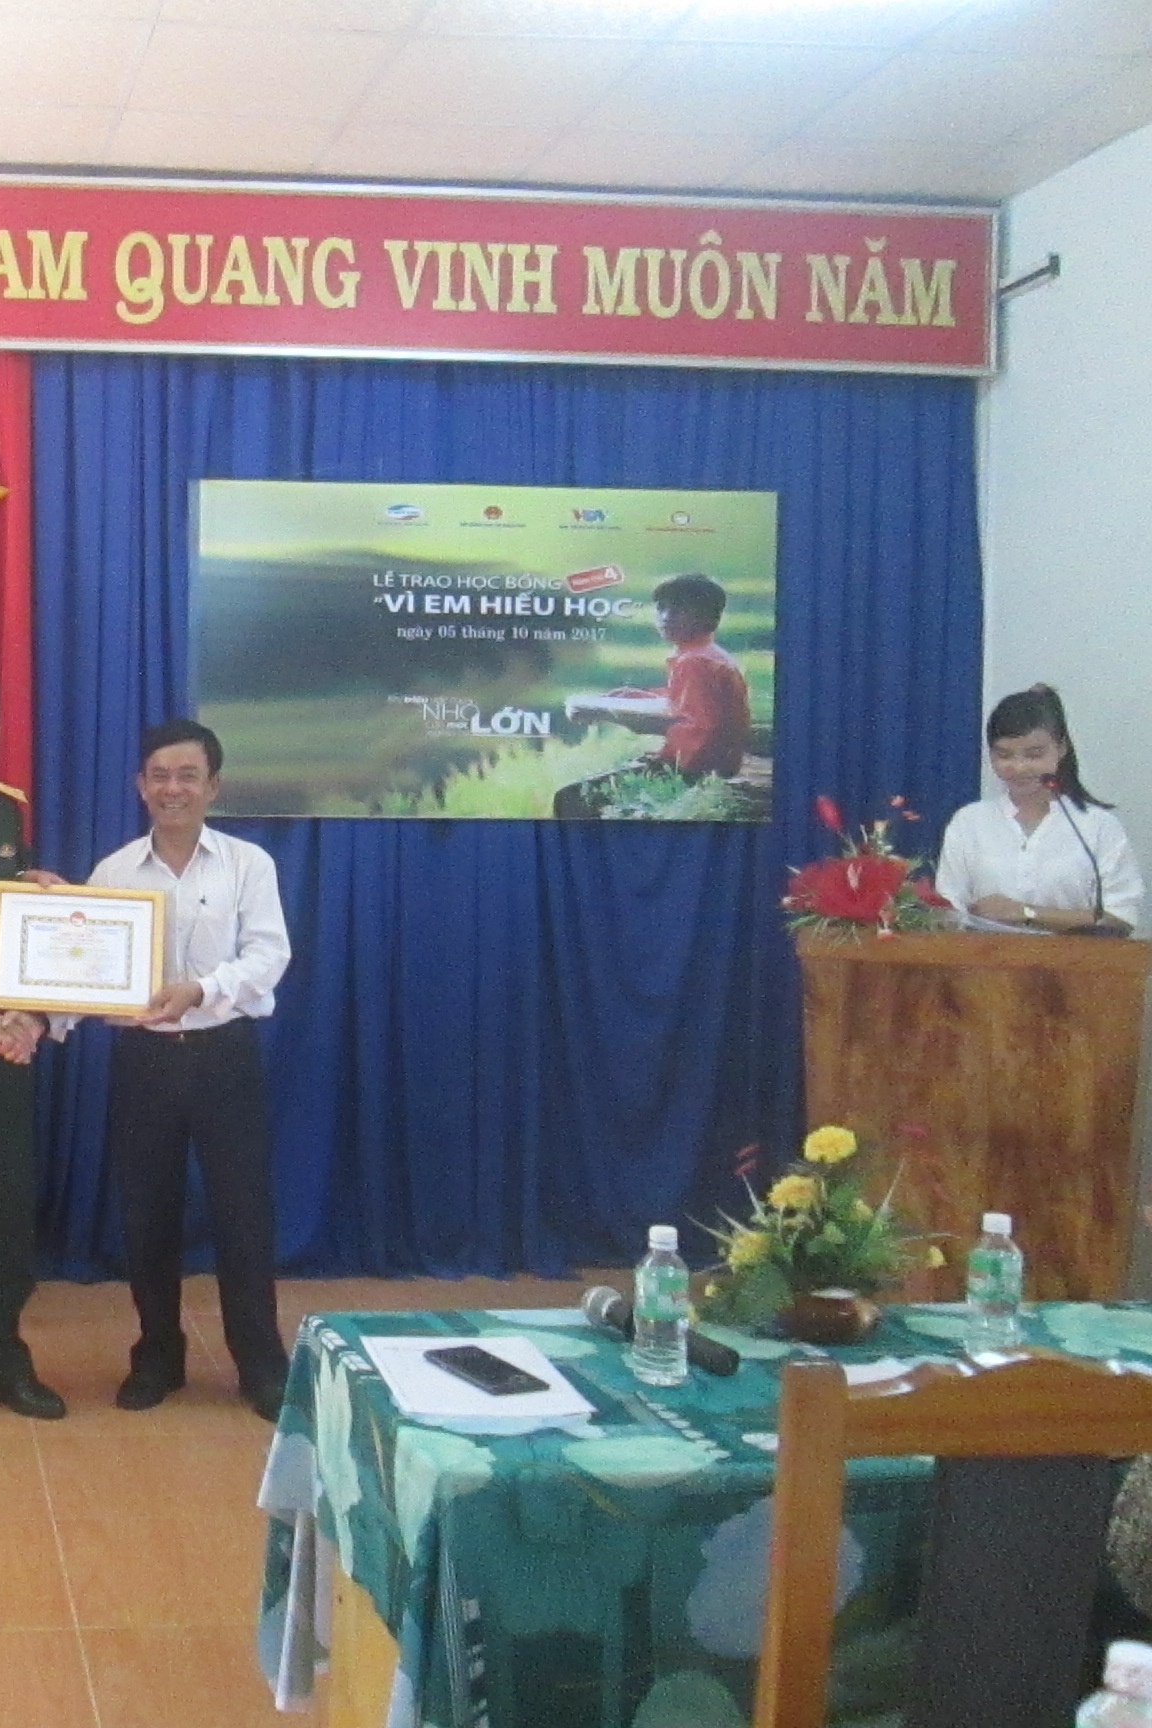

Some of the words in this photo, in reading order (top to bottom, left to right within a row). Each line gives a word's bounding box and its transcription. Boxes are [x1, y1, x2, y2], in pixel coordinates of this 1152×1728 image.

[114, 231, 359, 325] QUANG
[384, 239, 558, 314] VINH
[582, 230, 782, 321] MUÔN
[805, 236, 957, 328] NĂM
[399, 574, 452, 589] TRAO
[457, 575, 500, 592] HỌC
[424, 595, 471, 614] EM
[480, 591, 555, 616] HIẾU
[397, 626, 433, 640] ngày
[462, 626, 505, 641] tháng
[471, 706, 551, 734] LỚN
